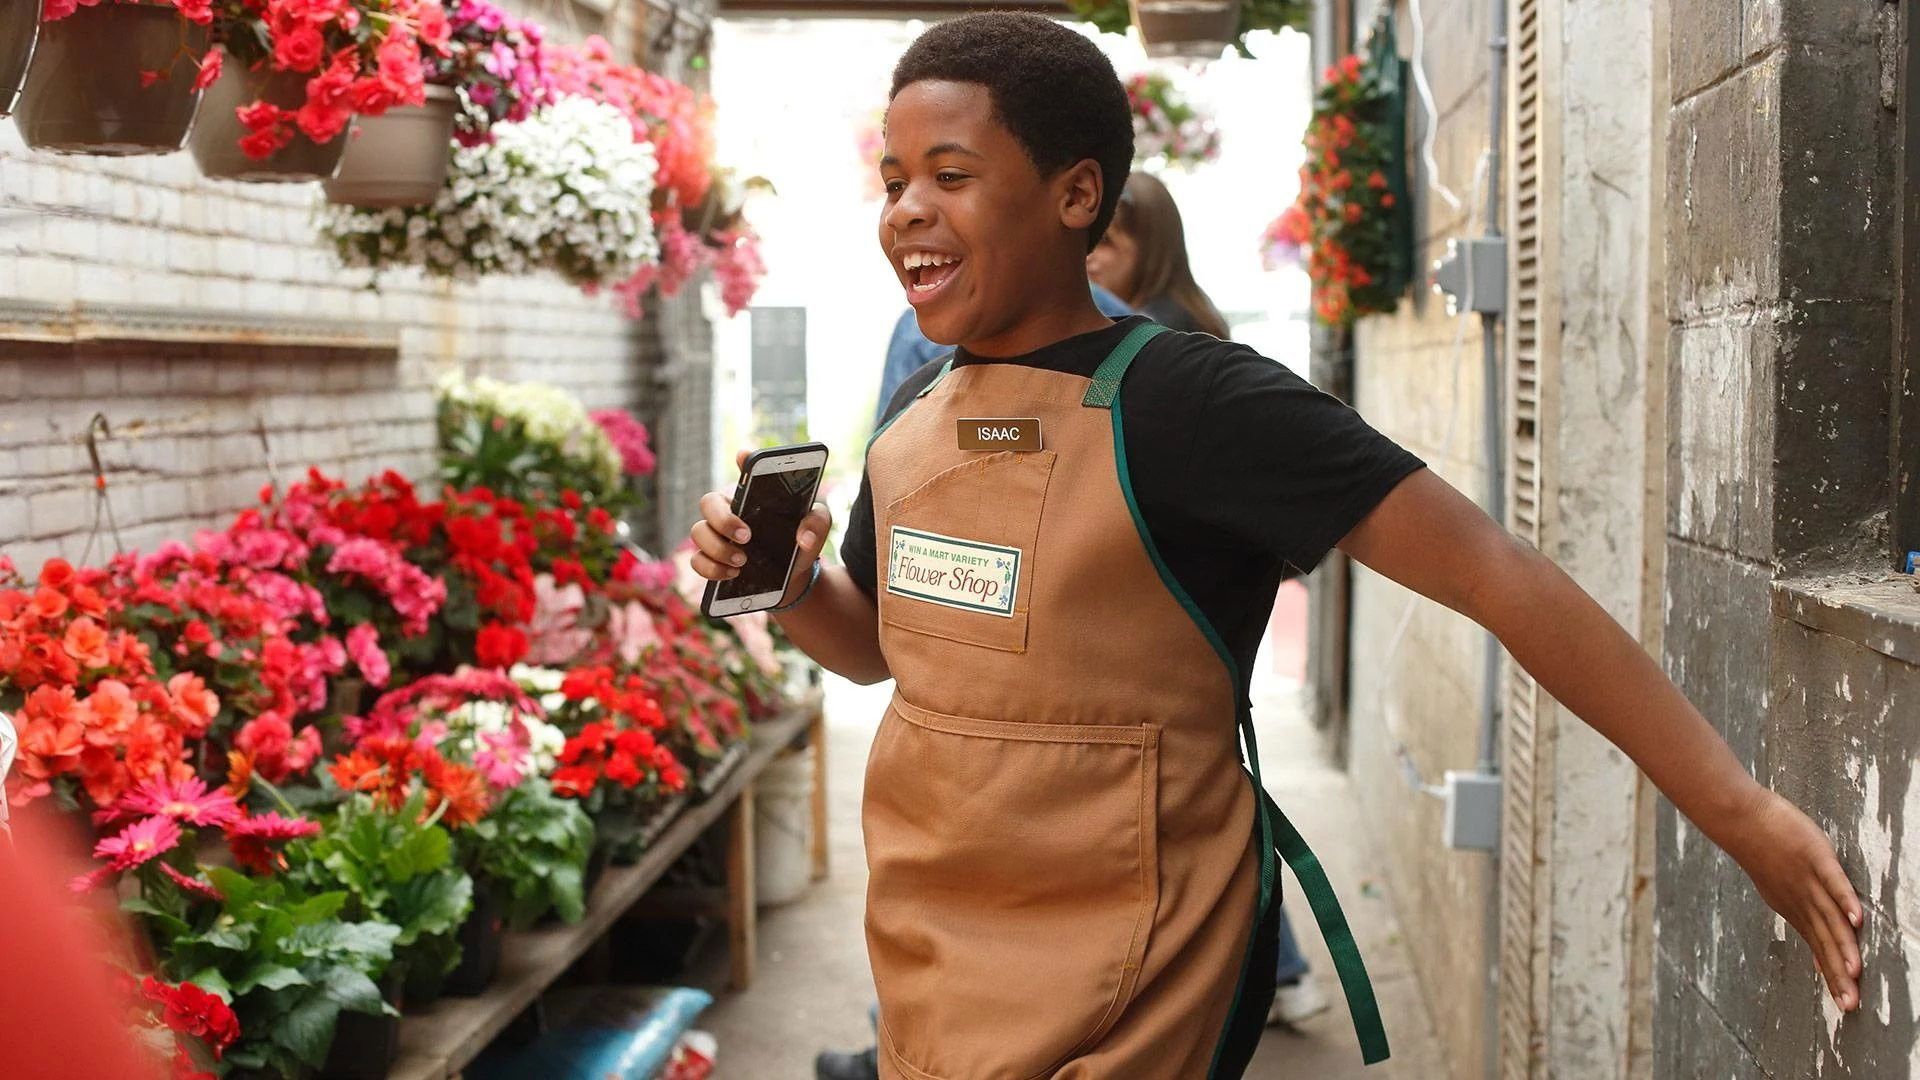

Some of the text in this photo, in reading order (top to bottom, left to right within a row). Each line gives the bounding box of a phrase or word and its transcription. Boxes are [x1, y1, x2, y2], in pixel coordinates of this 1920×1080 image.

[977, 427, 1020, 440] ISAAC
[908, 544, 989, 567] WIN A MART VARIETY
[897, 556, 998, 602] Flower Shop
